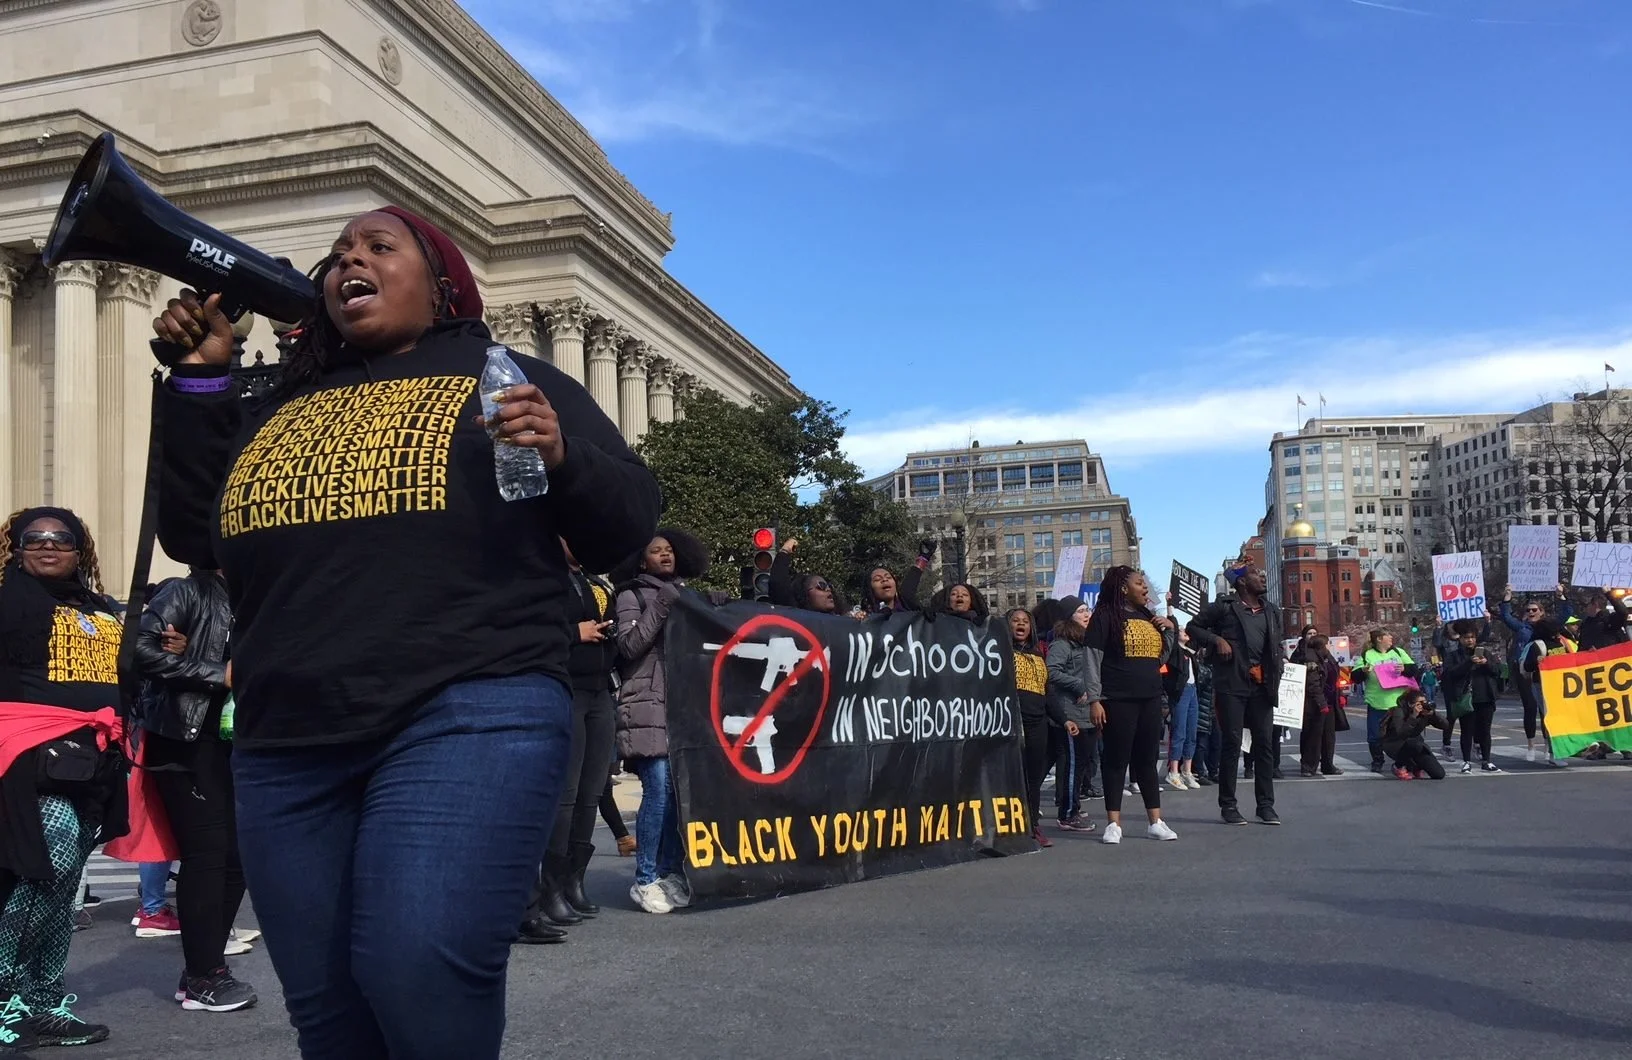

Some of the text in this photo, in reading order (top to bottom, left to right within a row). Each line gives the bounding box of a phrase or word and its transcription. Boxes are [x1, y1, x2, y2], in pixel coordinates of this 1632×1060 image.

[265, 389, 468, 425] #BLACKLIVESMATTER
[276, 376, 477, 413] #BLACKLIVESMATTER
[242, 413, 456, 452] #BLACKLIVESMATTER
[253, 400, 462, 440] #BLACKLIVESMATTER
[225, 448, 448, 491] #BLACKLIVESMATTER
[232, 429, 451, 471] #BLACKLIVESMATTER
[221, 465, 446, 514] #BLACKLIVESMATTER
[221, 486, 446, 538] #BLACKLIVESMATTER
[1582, 543, 1632, 561] BLAC
[1589, 559, 1632, 574] LIVE
[1438, 596, 1485, 621] BETTER
[1441, 582, 1477, 601] DO
[845, 632, 873, 683] IN
[832, 694, 1012, 743] IN NEIGHBORHOODS
[687, 816, 796, 868] BLACK
[811, 808, 906, 857] YOUTH
